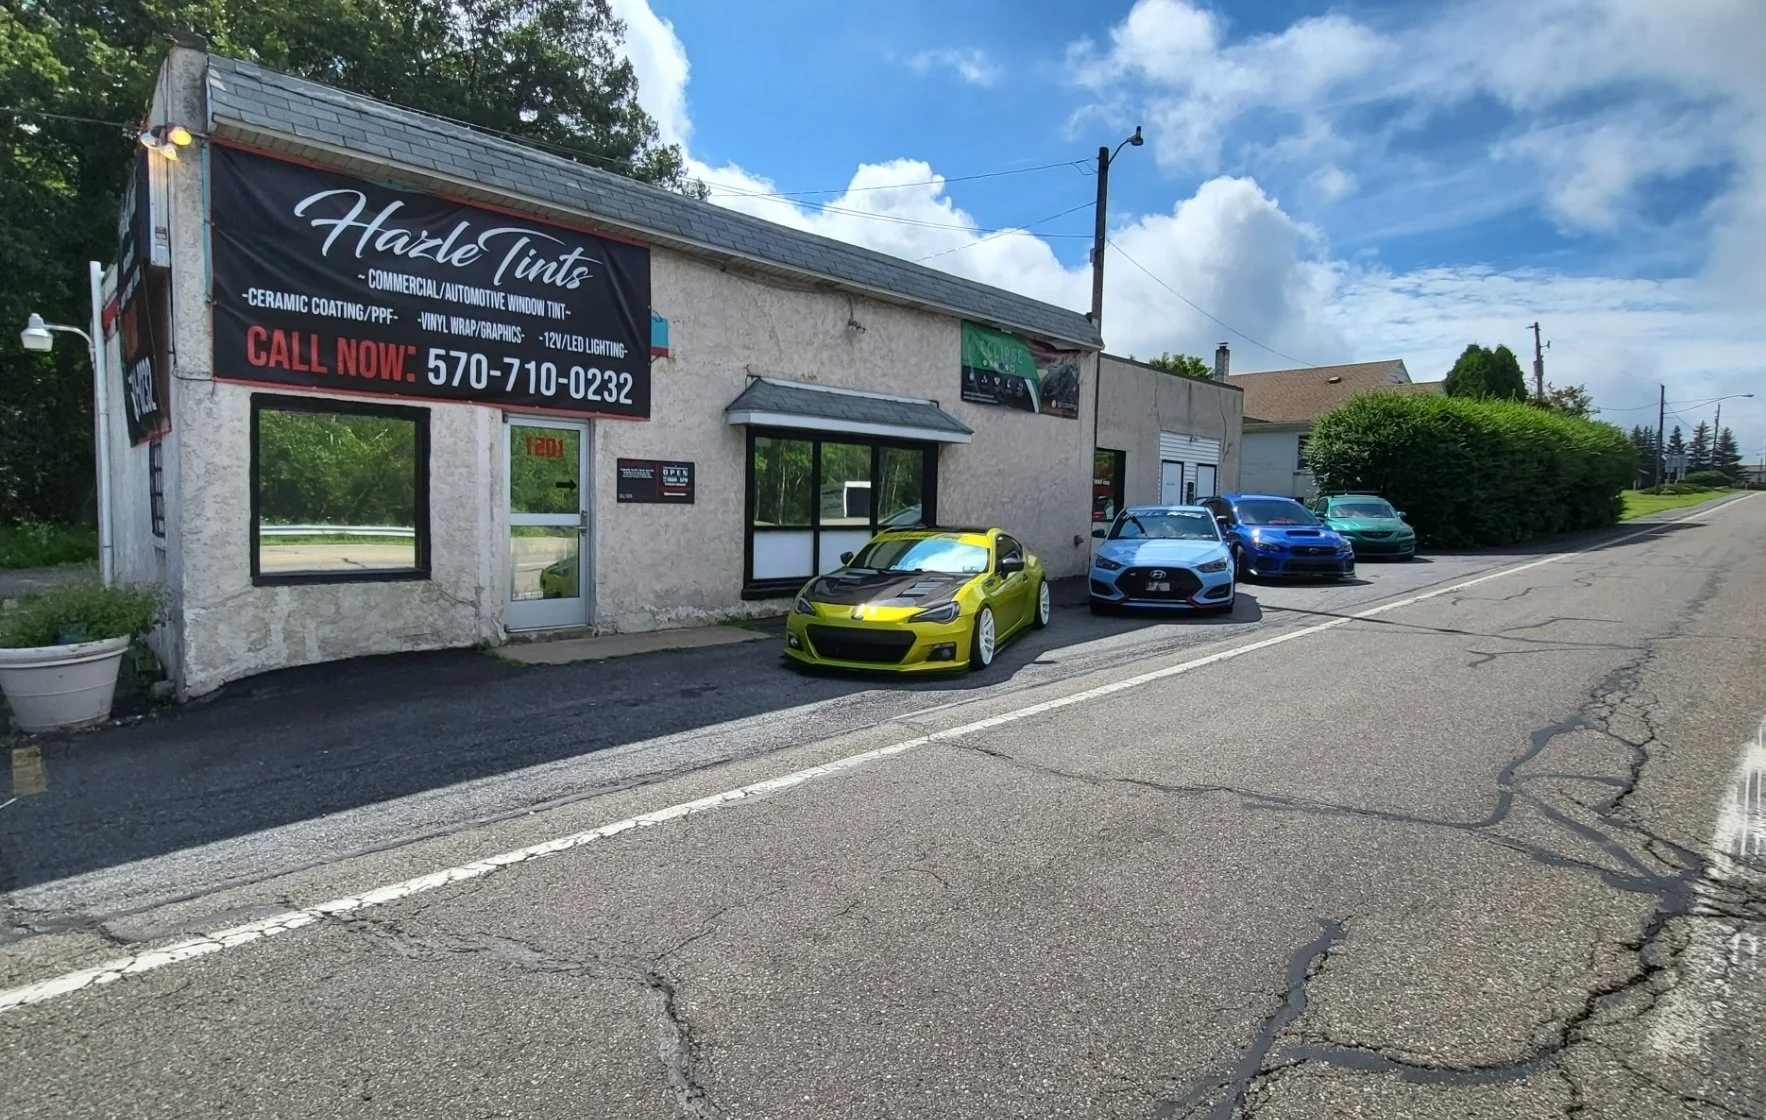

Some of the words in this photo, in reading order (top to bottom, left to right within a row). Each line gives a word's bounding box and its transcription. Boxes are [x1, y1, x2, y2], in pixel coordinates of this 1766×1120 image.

[294, 189, 481, 267] Hazle
[478, 227, 604, 289] Tints
[368, 268, 505, 310] COMMERCIAL/AUTOMOTIVE
[508, 293, 545, 315] WINDOW
[247, 325, 328, 374] CALL
[336, 337, 416, 383] NOW:
[427, 347, 633, 405] 570-710-0232
[663, 469, 688, 477] OPEN
